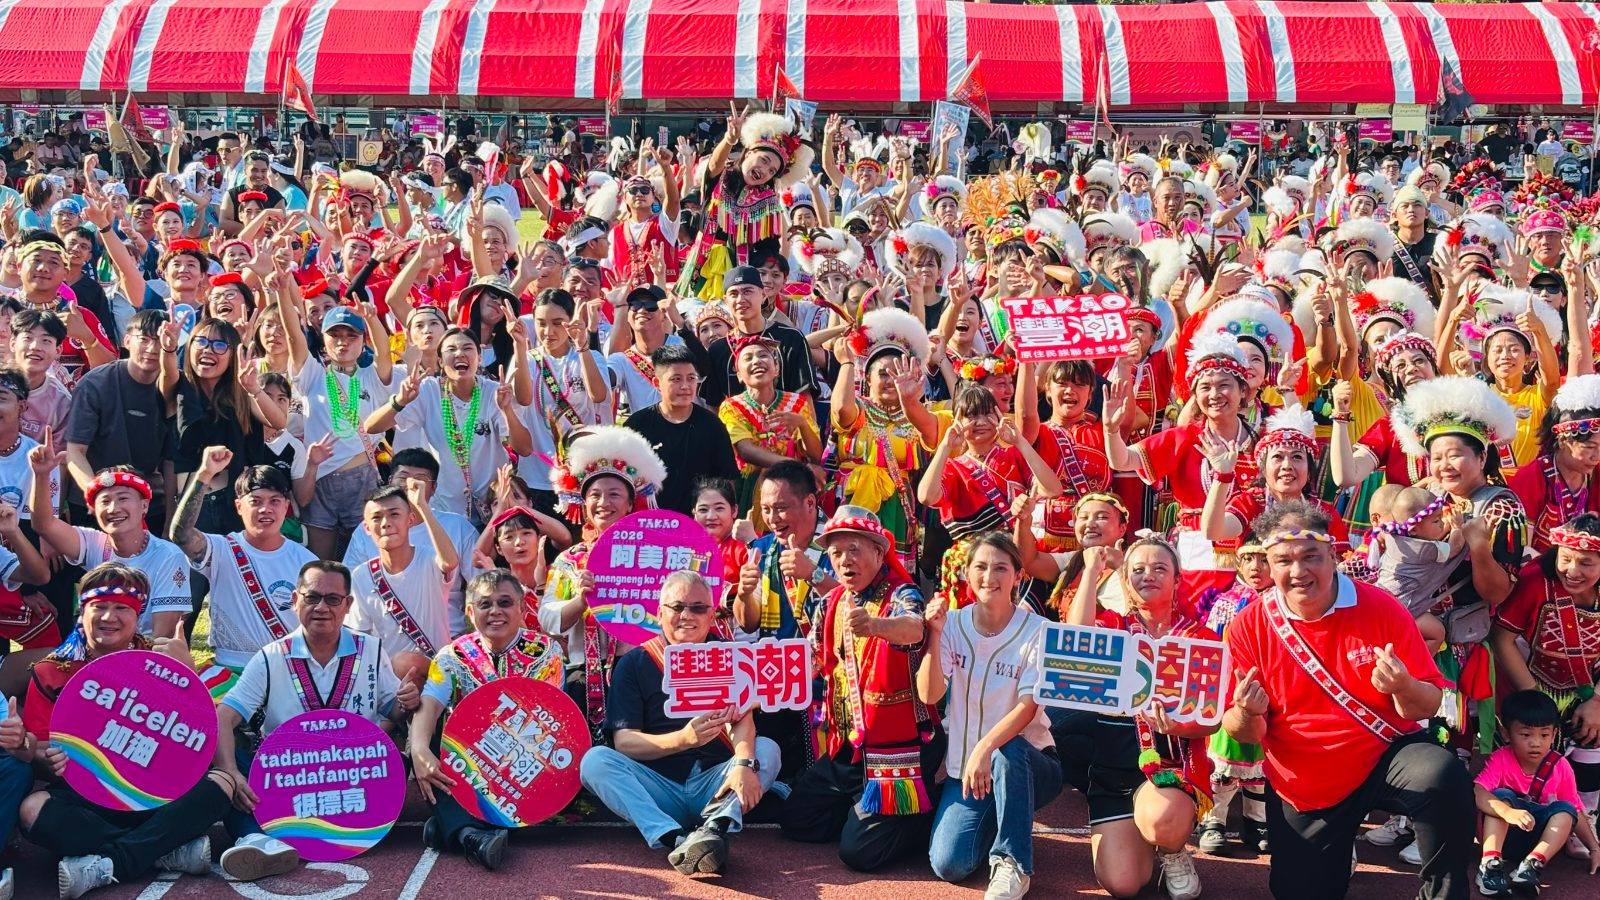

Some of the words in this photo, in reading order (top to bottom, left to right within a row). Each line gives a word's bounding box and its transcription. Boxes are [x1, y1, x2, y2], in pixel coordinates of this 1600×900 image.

[1004, 294, 1126, 315] TAKAO
[1014, 313, 1128, 346] 豐潮
[613, 531, 644, 540] 2026
[638, 518, 680, 528] TAKAO
[610, 544, 692, 569] 阿美族
[597, 587, 660, 600] 高雄市阿美族
[611, 602, 654, 624] 10.
[144, 658, 190, 688] TAKAO
[669, 643, 807, 713] 豐潮
[79, 679, 207, 752] sa'icelen
[300, 718, 347, 731] TAKAO
[531, 705, 561, 732] 2026
[96, 719, 159, 768] 加油
[490, 692, 573, 770] TAKAO
[259, 741, 388, 768] tadamakapah
[474, 722, 545, 788] 豐潮
[275, 760, 388, 788] tadafangcal
[292, 787, 367, 819] 很漂亮
